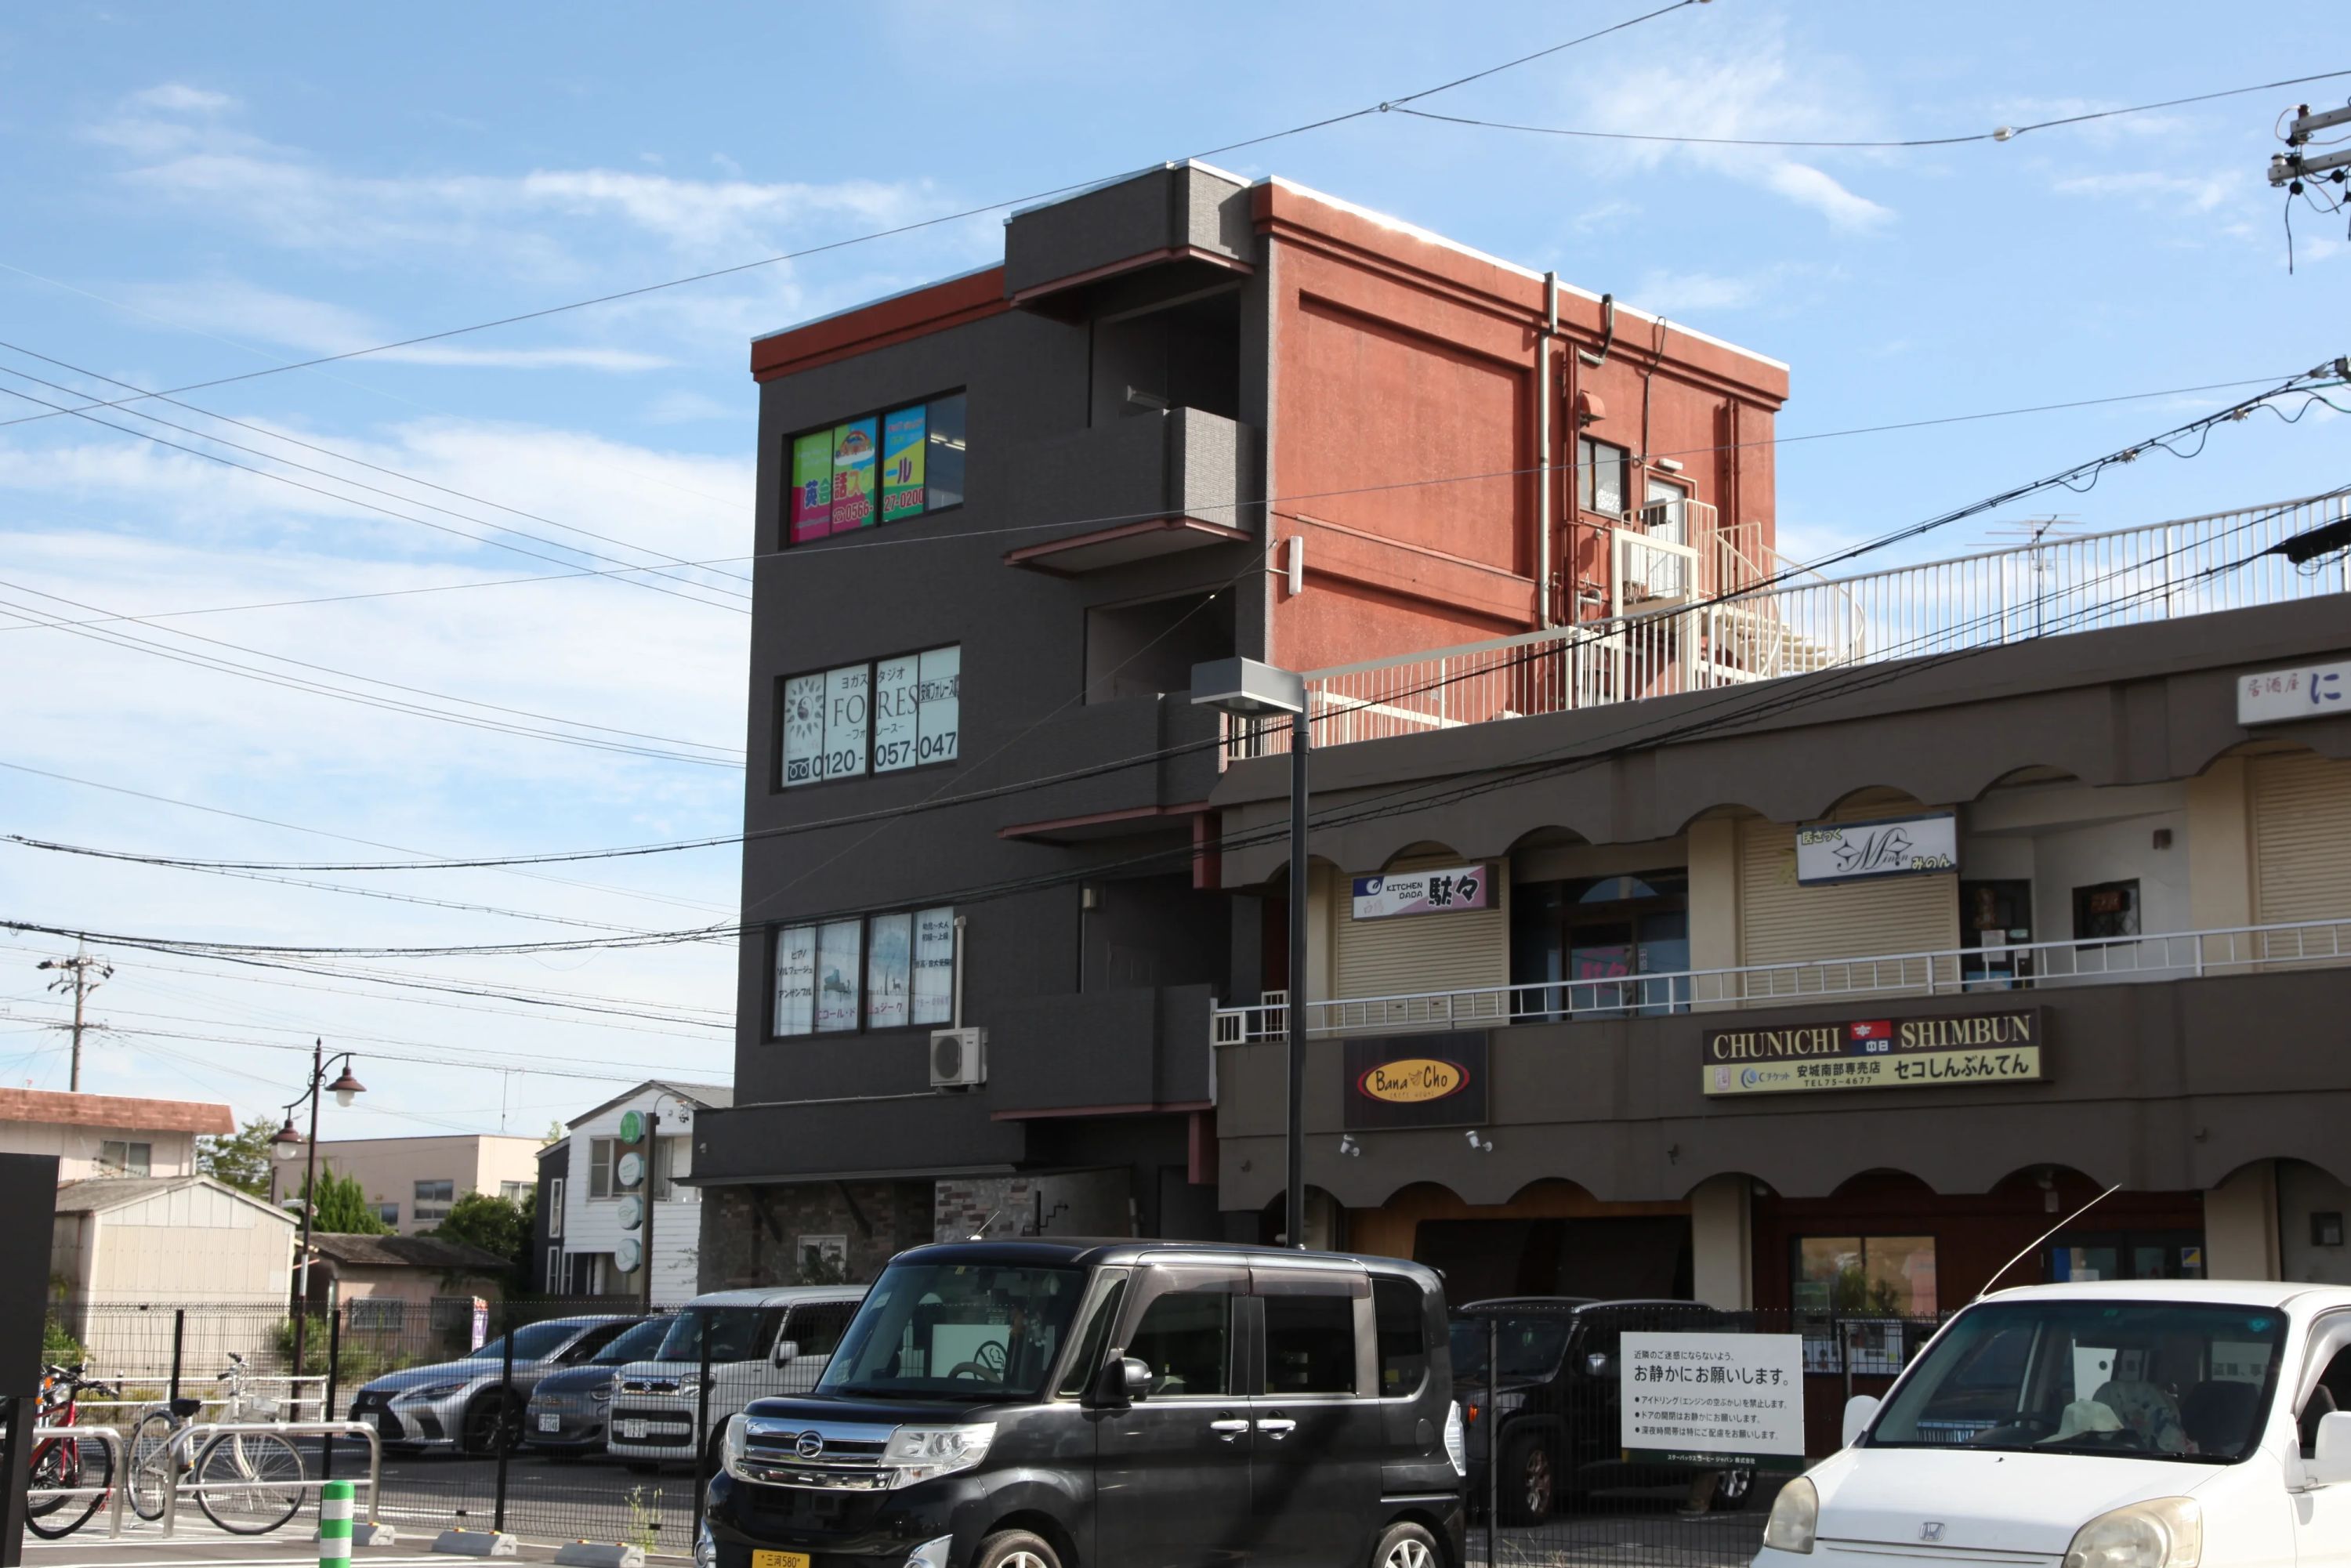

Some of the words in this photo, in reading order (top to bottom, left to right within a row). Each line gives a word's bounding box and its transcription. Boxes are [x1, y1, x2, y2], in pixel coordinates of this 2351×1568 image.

[804, 457, 912, 509] 英会話スクール
[846, 487, 924, 521] 0566-27-0200
[842, 667, 905, 689] ヨガスタジオ
[2310, 673, 2342, 704] に
[812, 732, 956, 777] 0120-057-047
[1911, 853, 1951, 871] みのん
[1386, 882, 1423, 892] KITCHEN
[1399, 891, 1423, 900] DADA
[1428, 875, 1480, 906] 駄々
[791, 949, 806, 960] ピアノ
[1713, 1027, 1841, 1059] CHUNICHI
[1900, 1015, 2031, 1048] SHIMBUN
[1866, 1040, 1888, 1052] 中日
[1796, 1061, 1881, 1078] 安城南部専売店
[1894, 1052, 2029, 1081] セコしんぶんてん
[1375, 1070, 1408, 1092] Bana
[1423, 1066, 1448, 1088] Cho
[1634, 1364, 1789, 1387] お静かにお願いします。
[766, 1554, 781, 1567] 三河
[782, 1555, 797, 1568] 580
